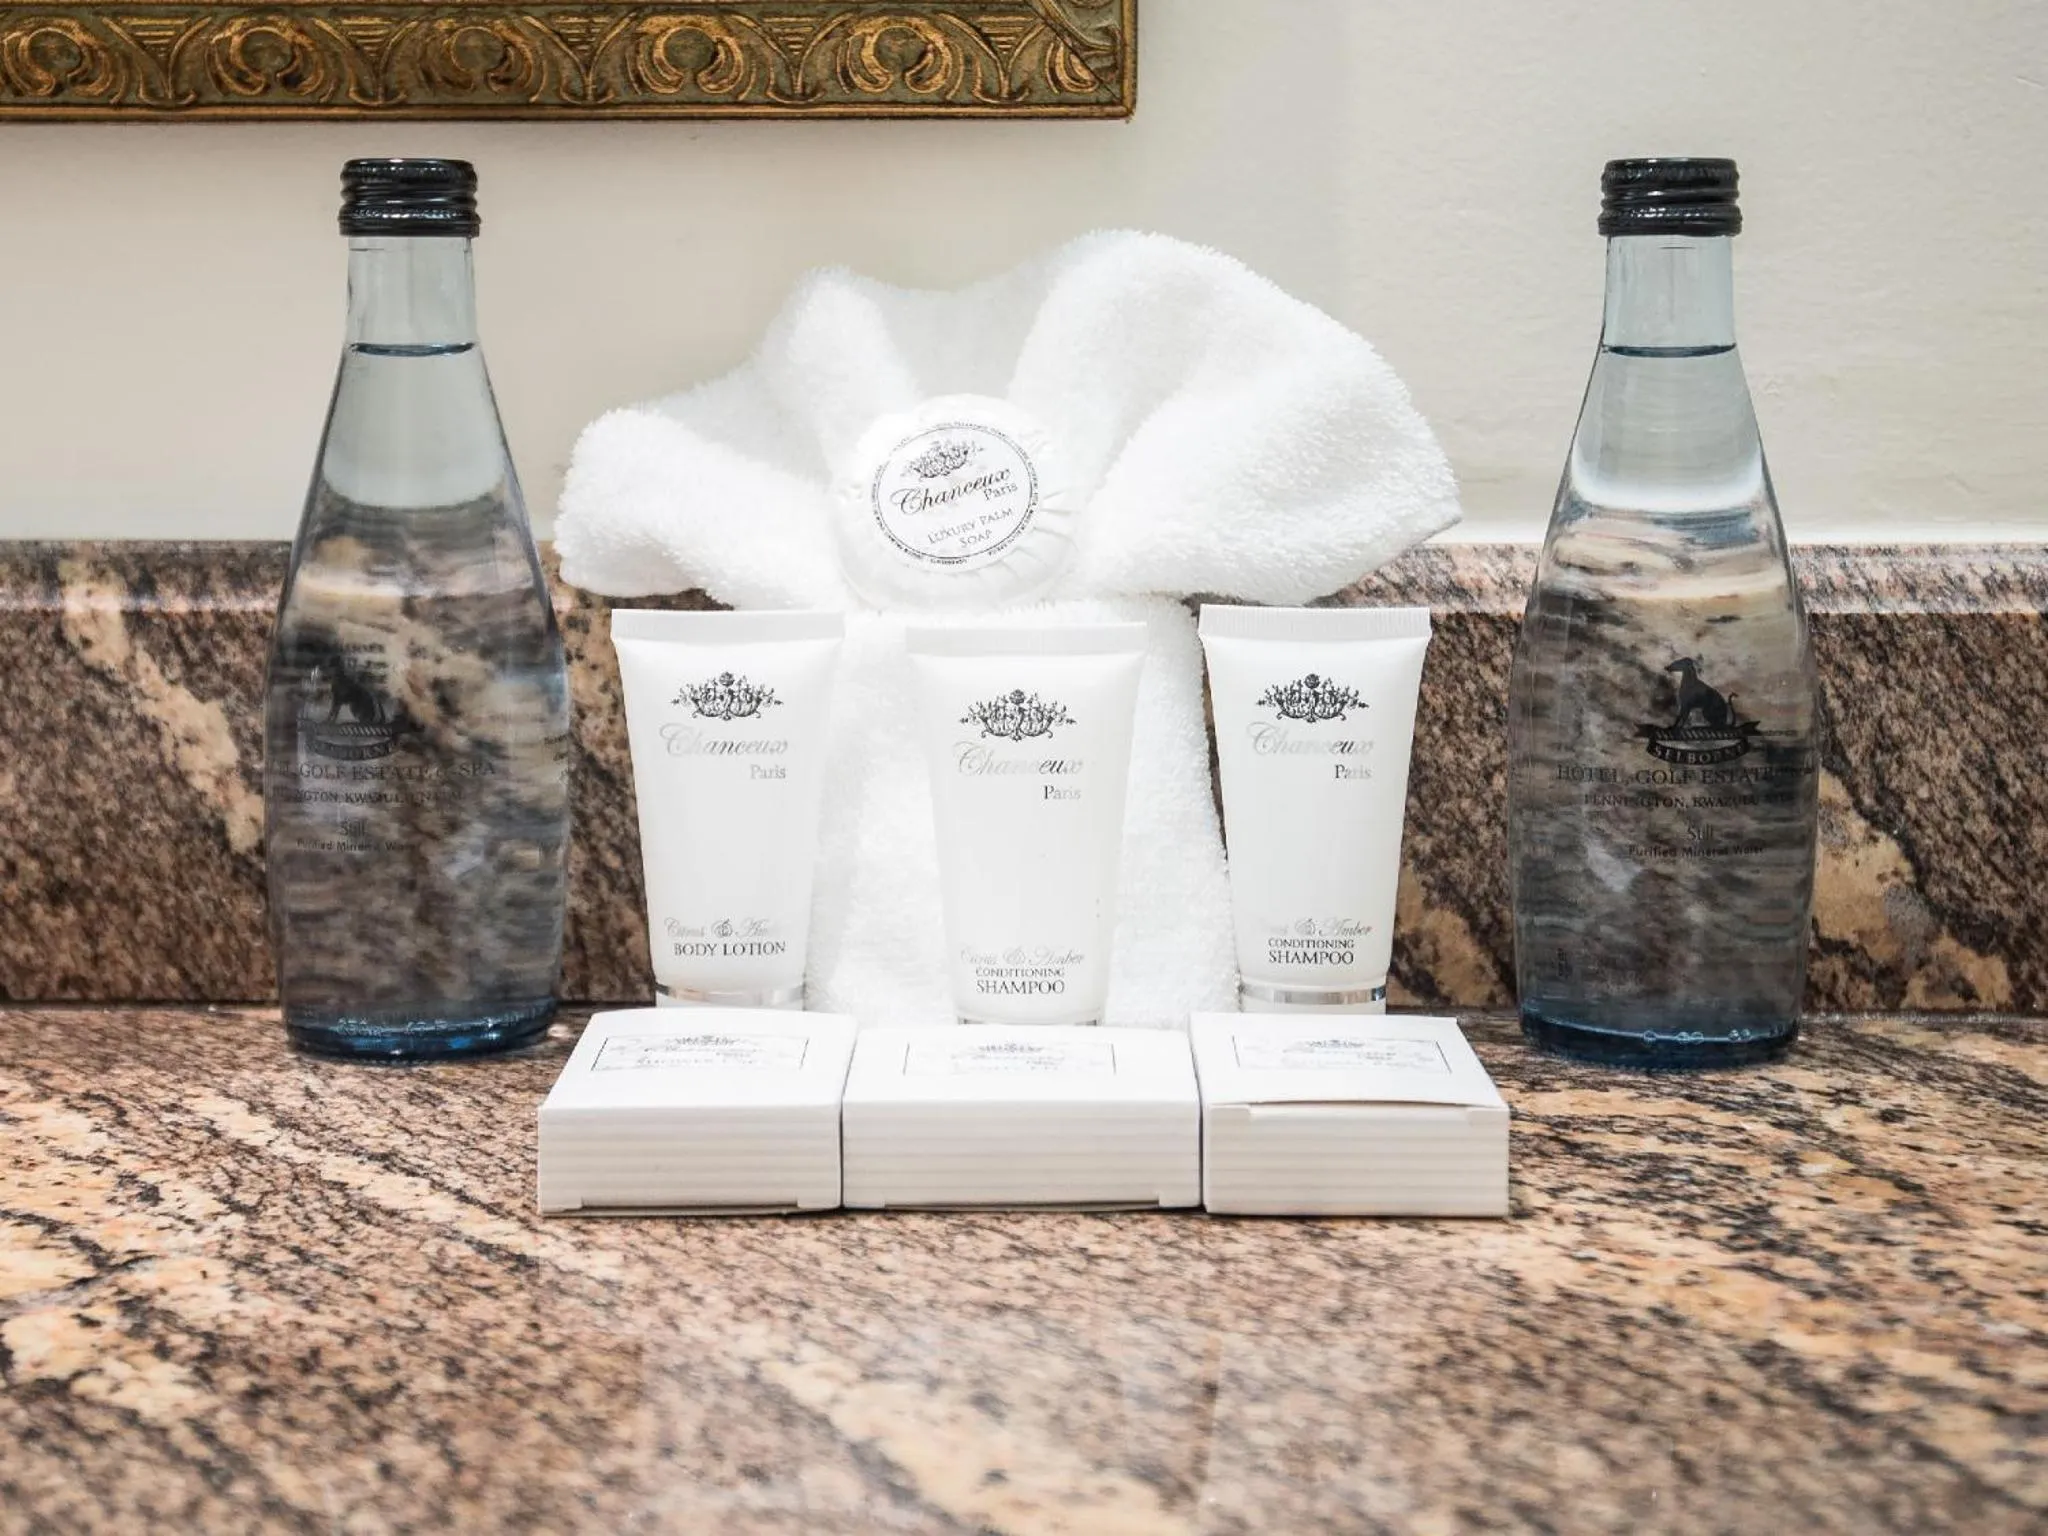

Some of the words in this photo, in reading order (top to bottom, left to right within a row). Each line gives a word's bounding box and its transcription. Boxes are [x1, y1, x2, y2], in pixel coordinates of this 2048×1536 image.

[889, 469, 1010, 514] Chanceux
[984, 483, 1018, 500] Paris
[927, 520, 976, 544] LUXURY
[979, 508, 1013, 526] PALM
[959, 530, 993, 548] SOAP
[658, 722, 788, 757] Chanceux
[750, 763, 787, 780] Paris
[1334, 763, 1372, 780] Paris
[1635, 767, 1692, 785] GOLF
[1042, 784, 1082, 800] Paris
[674, 943, 717, 956] BODY
[723, 941, 786, 956] LOTION
[1267, 937, 1355, 949] CONDITIONING
[1268, 950, 1355, 965] SHAMPOO
[975, 967, 1066, 978] CONDITIONING
[975, 979, 1066, 995] SHAMPOO
